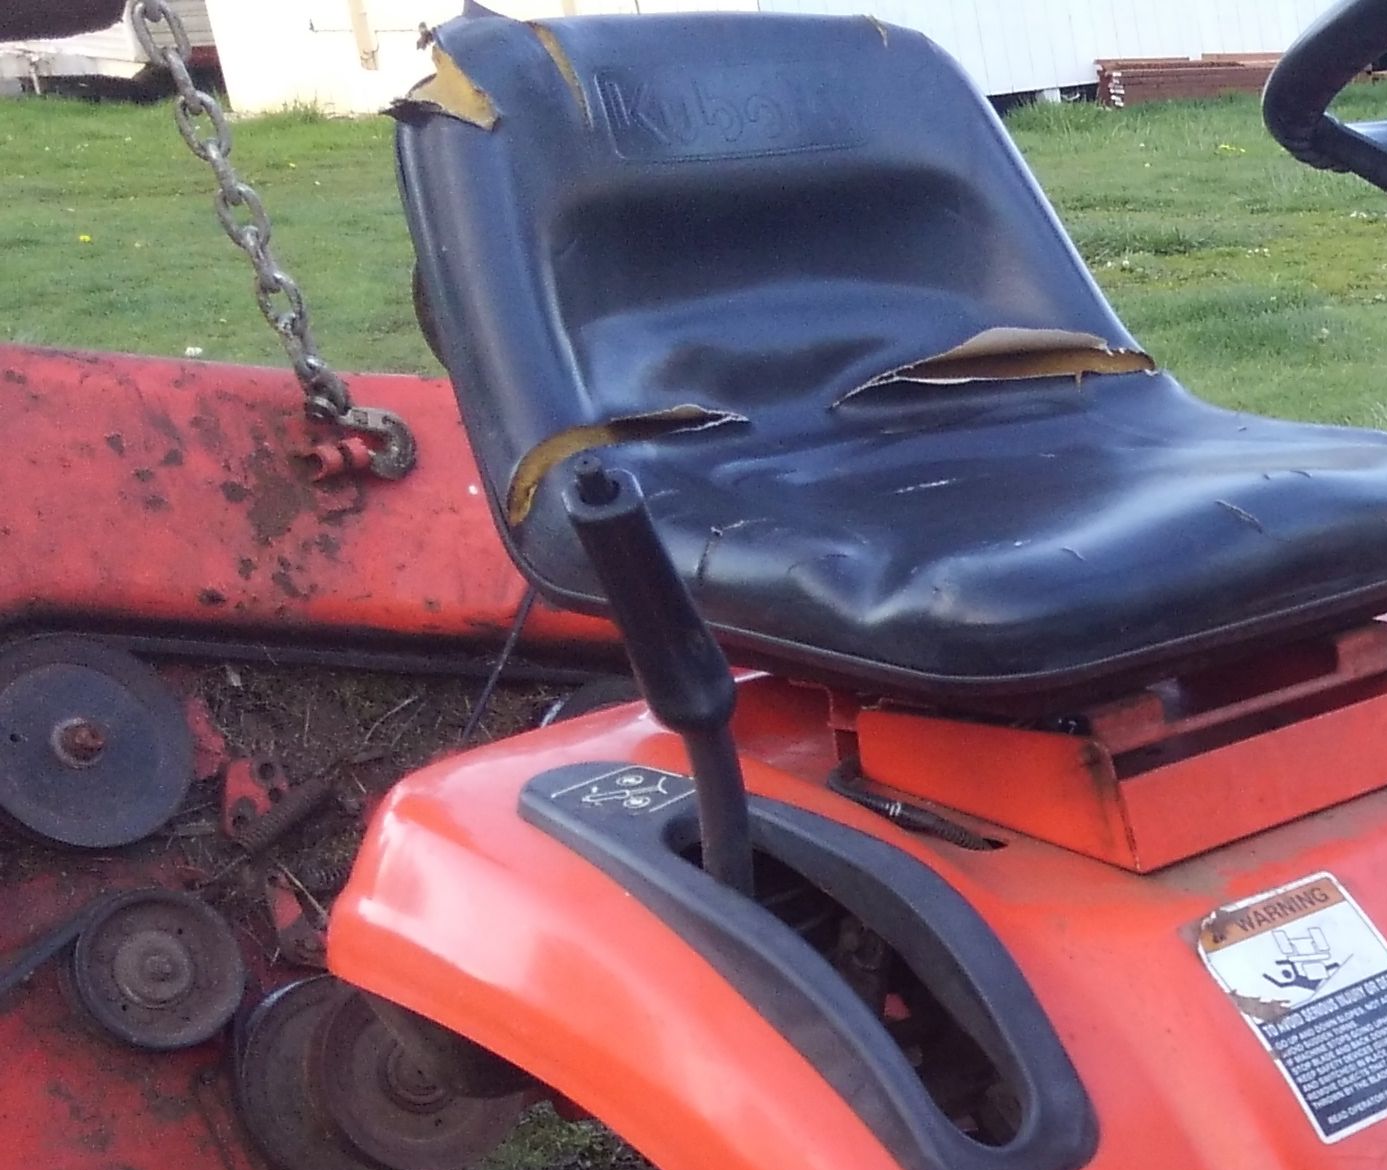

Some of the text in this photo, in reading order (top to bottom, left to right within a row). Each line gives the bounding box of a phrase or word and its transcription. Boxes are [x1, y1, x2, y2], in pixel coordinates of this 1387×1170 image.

[1235, 887, 1328, 932] WARNING
[1262, 1023, 1279, 1038] TO
[1275, 1012, 1304, 1033] AVOID
[1300, 997, 1338, 1022] SERIOUS
[1334, 985, 1367, 1007] INJURY
[1362, 980, 1379, 994] OR
